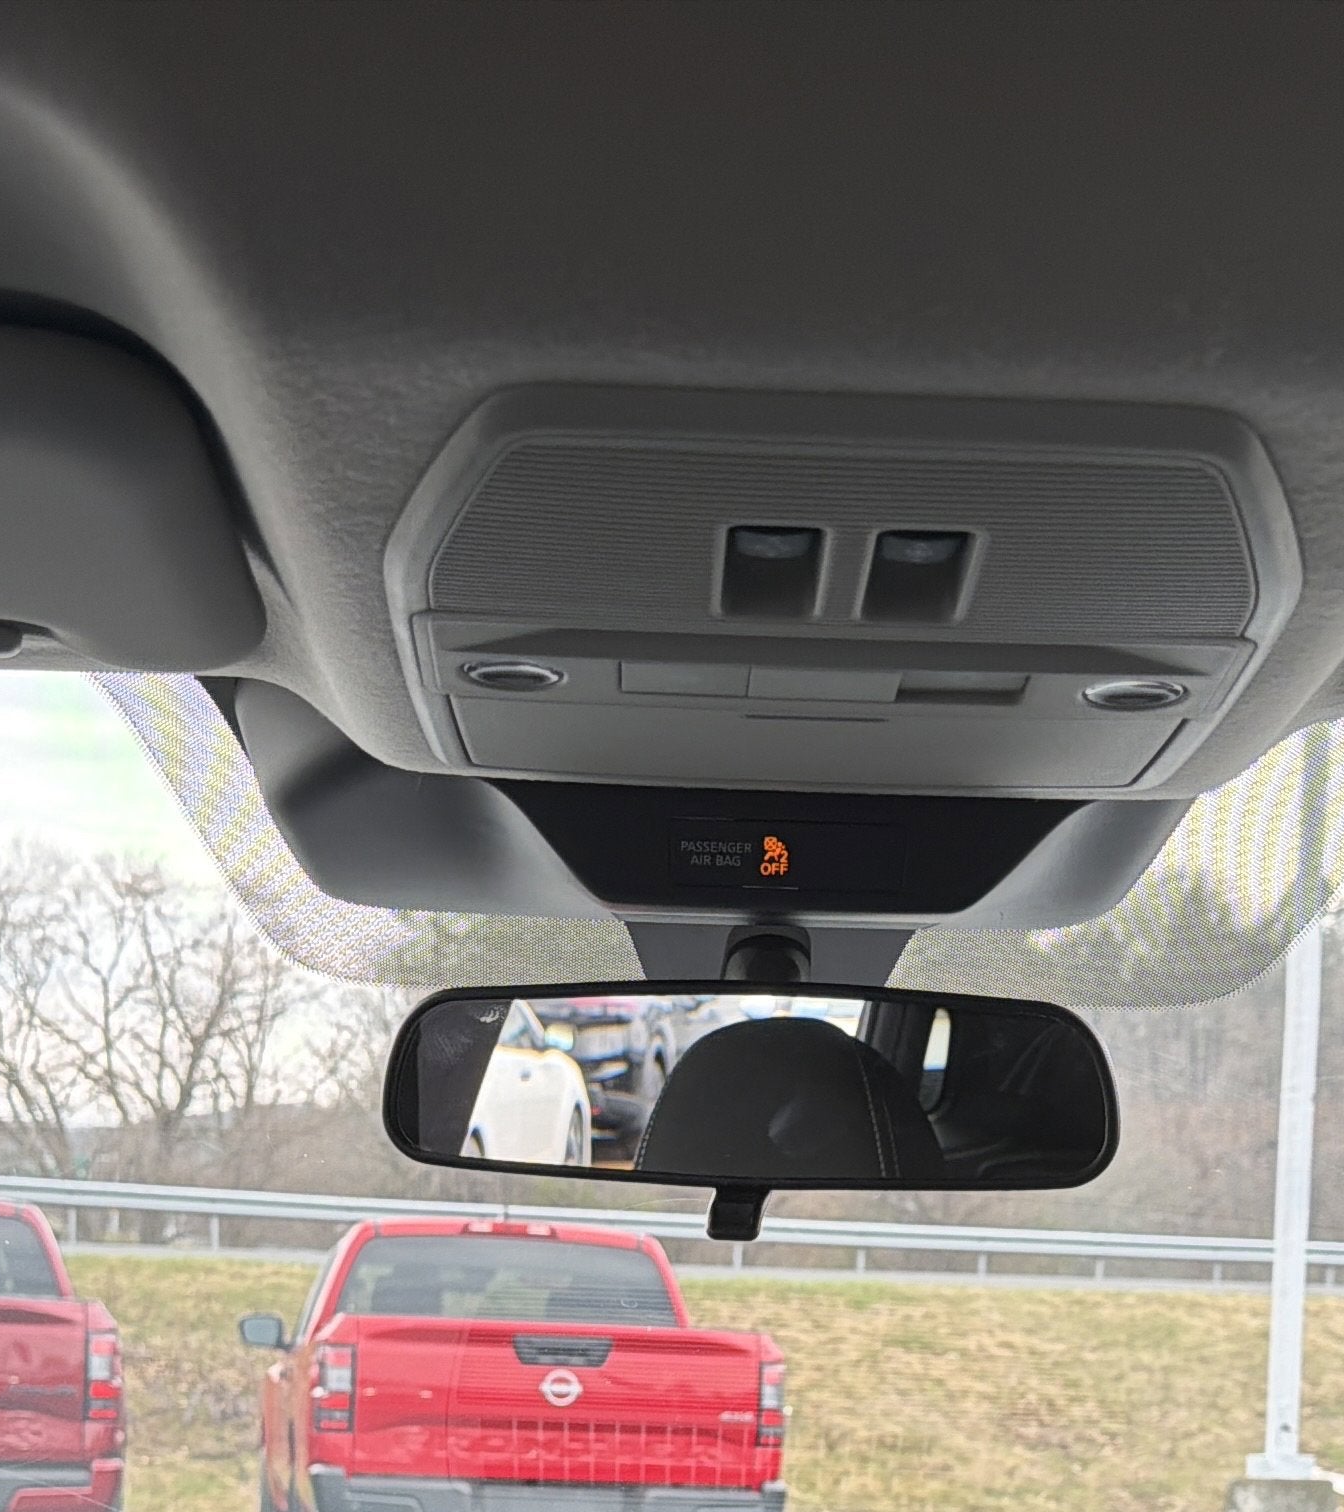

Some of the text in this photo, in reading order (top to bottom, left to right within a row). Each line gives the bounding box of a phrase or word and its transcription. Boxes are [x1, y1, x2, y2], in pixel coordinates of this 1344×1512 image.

[680, 840, 753, 853] PASSENGER
[690, 854, 741, 867] AIR BAG
[759, 862, 789, 876] OFF
